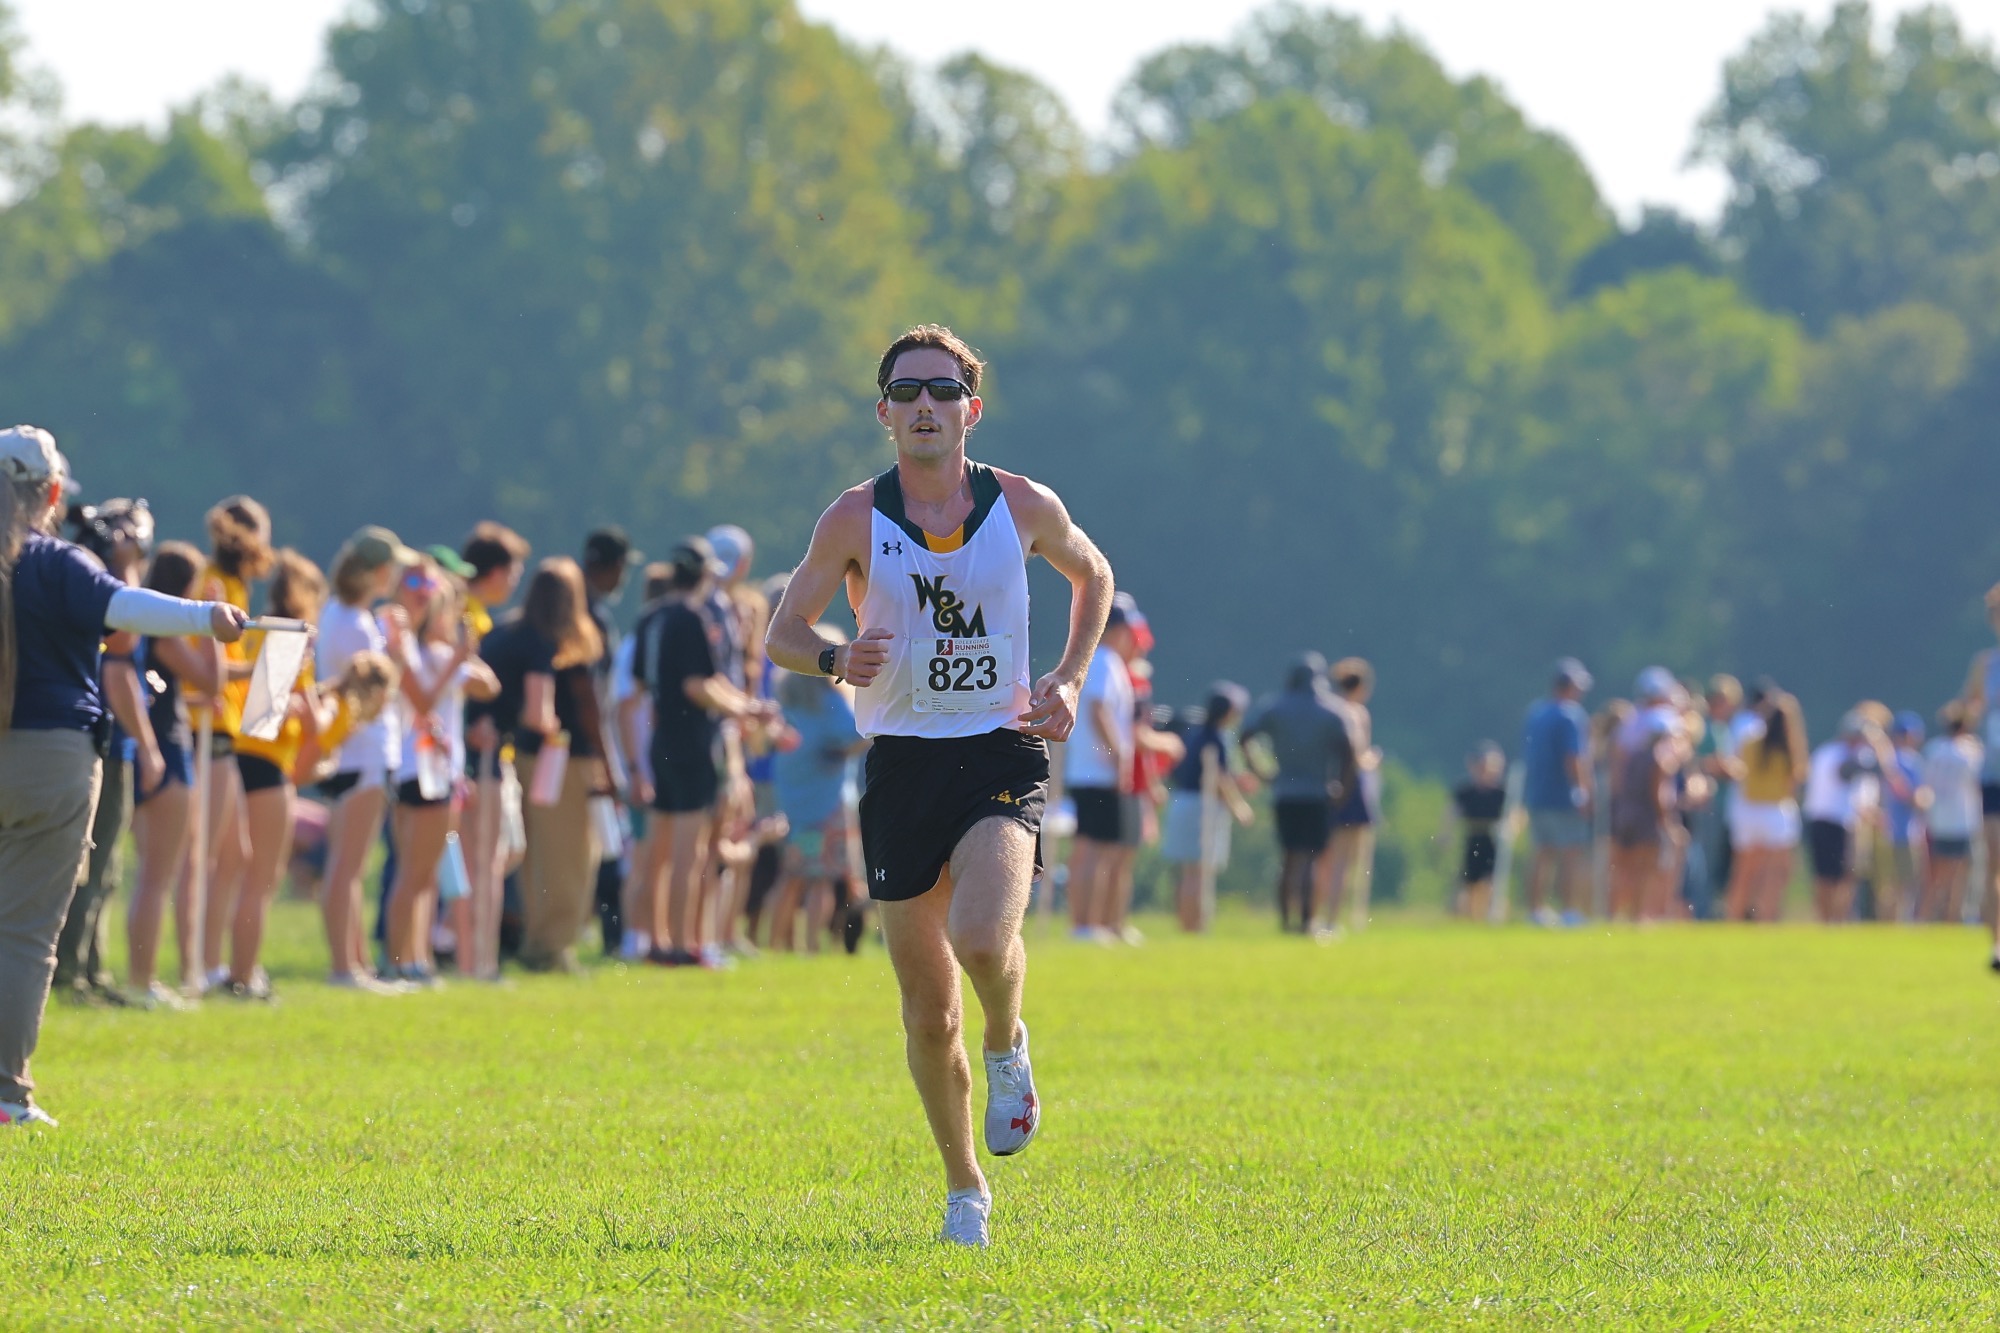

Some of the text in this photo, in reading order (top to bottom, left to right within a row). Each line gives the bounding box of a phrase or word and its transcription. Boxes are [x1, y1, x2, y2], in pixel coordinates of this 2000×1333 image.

[907, 573, 988, 638] W&M
[955, 643, 990, 651] RUNNING
[928, 655, 998, 692] 823
